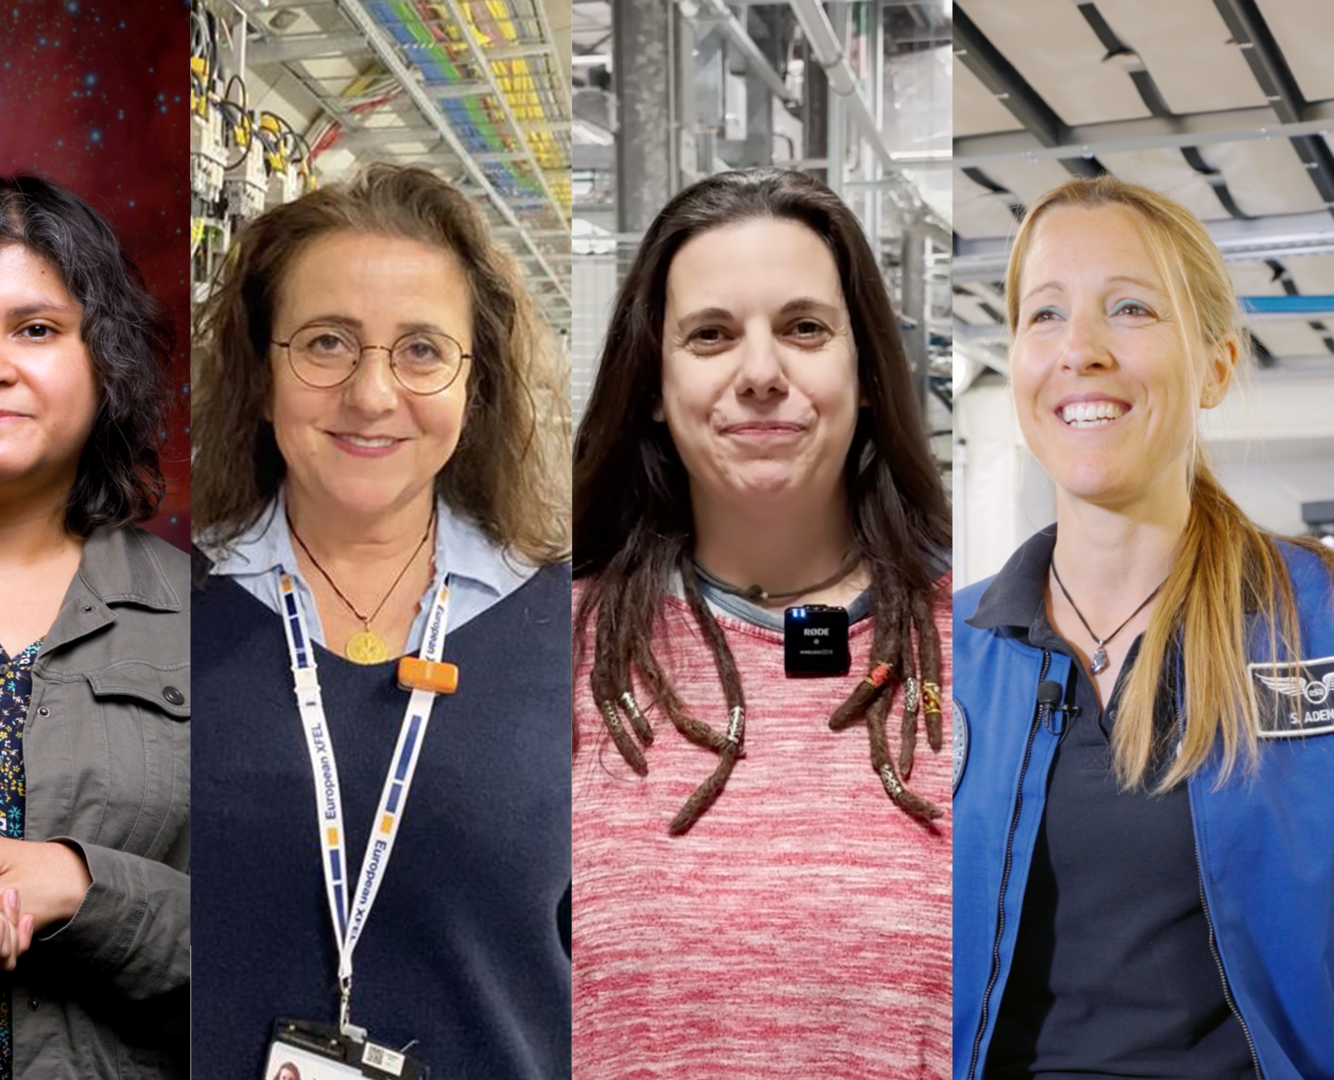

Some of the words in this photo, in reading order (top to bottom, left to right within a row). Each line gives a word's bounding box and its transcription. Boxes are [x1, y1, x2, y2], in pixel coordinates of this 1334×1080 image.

[803, 628, 829, 636] RØDE
[311, 722, 327, 755] XFEL
[320, 755, 338, 820] European
[359, 840, 387, 905] European
